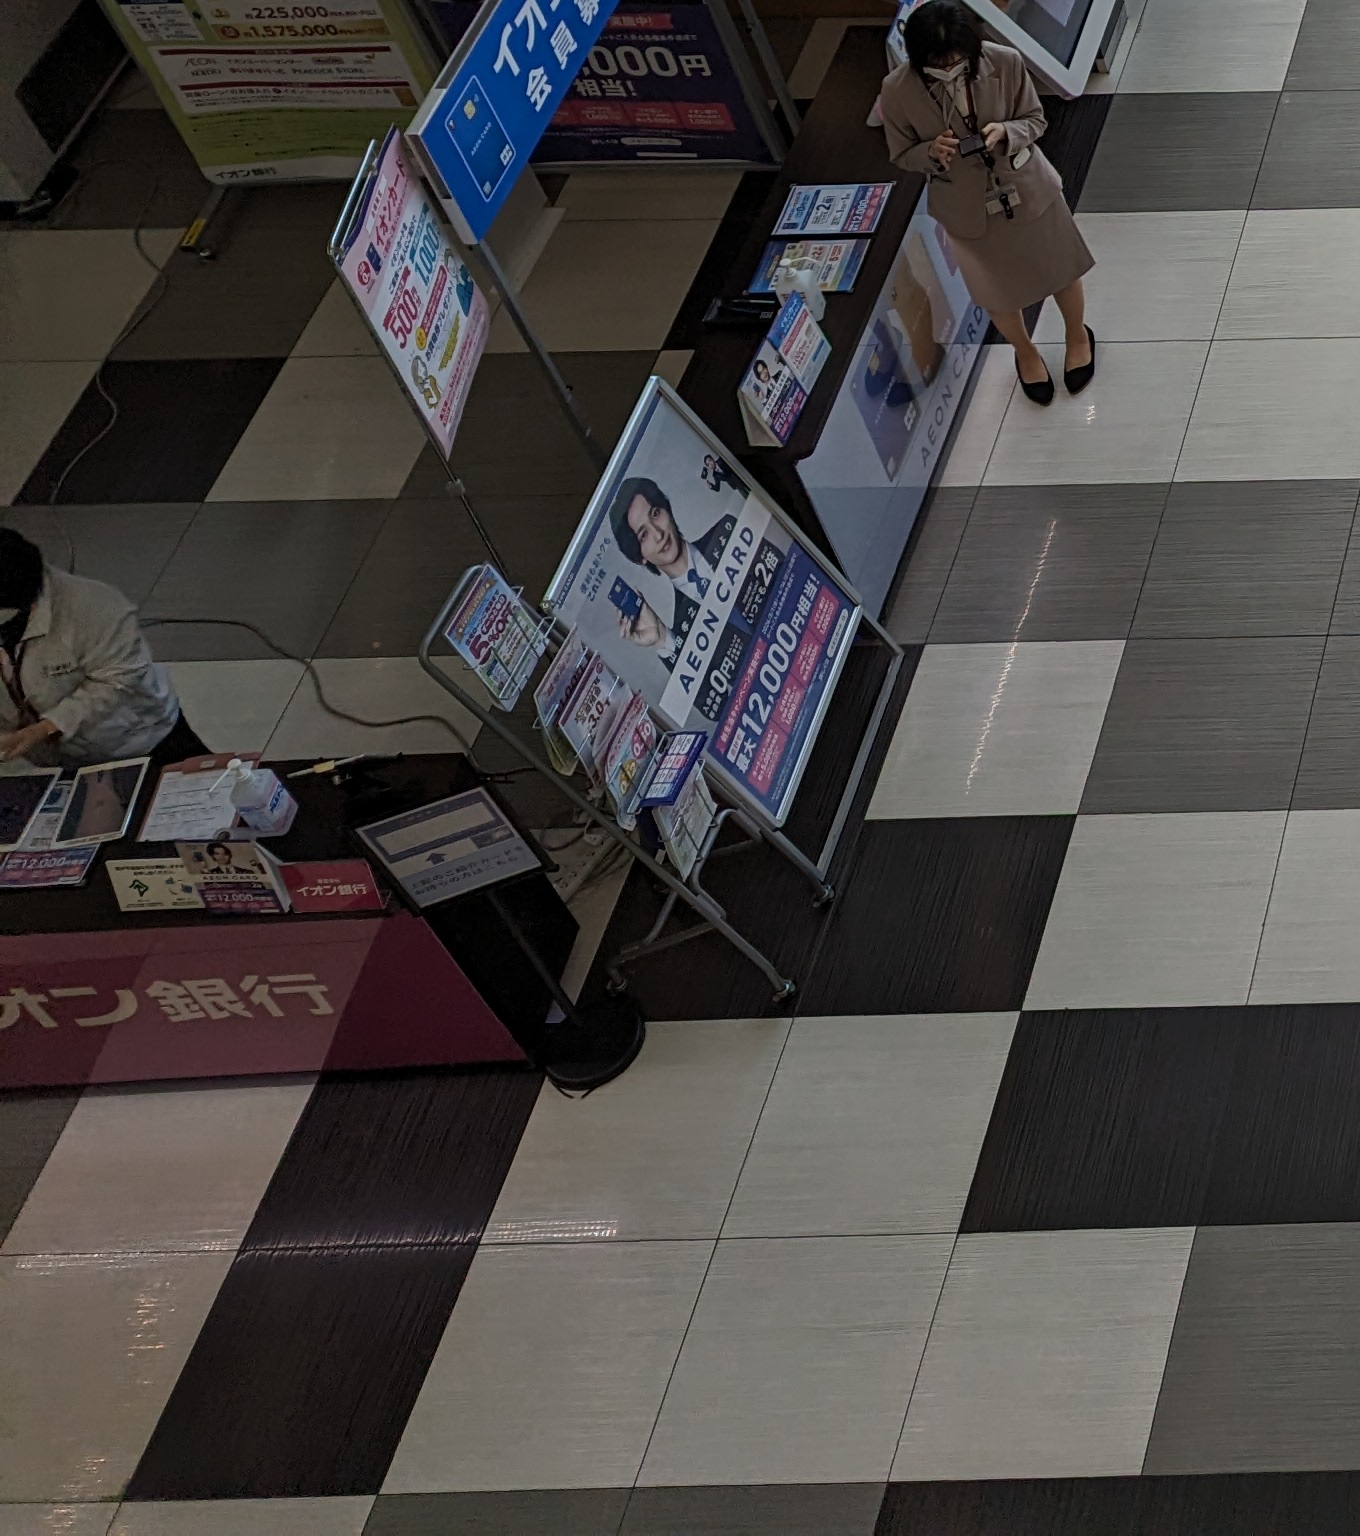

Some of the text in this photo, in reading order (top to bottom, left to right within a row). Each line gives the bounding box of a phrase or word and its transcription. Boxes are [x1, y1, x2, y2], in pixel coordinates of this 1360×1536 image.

[215, 167, 276, 178] イオン銀行
[921, 306, 984, 468] AEON CARD
[680, 613, 722, 695] AEON
[714, 524, 756, 605] CARD
[295, 883, 368, 898] イオン銀行
